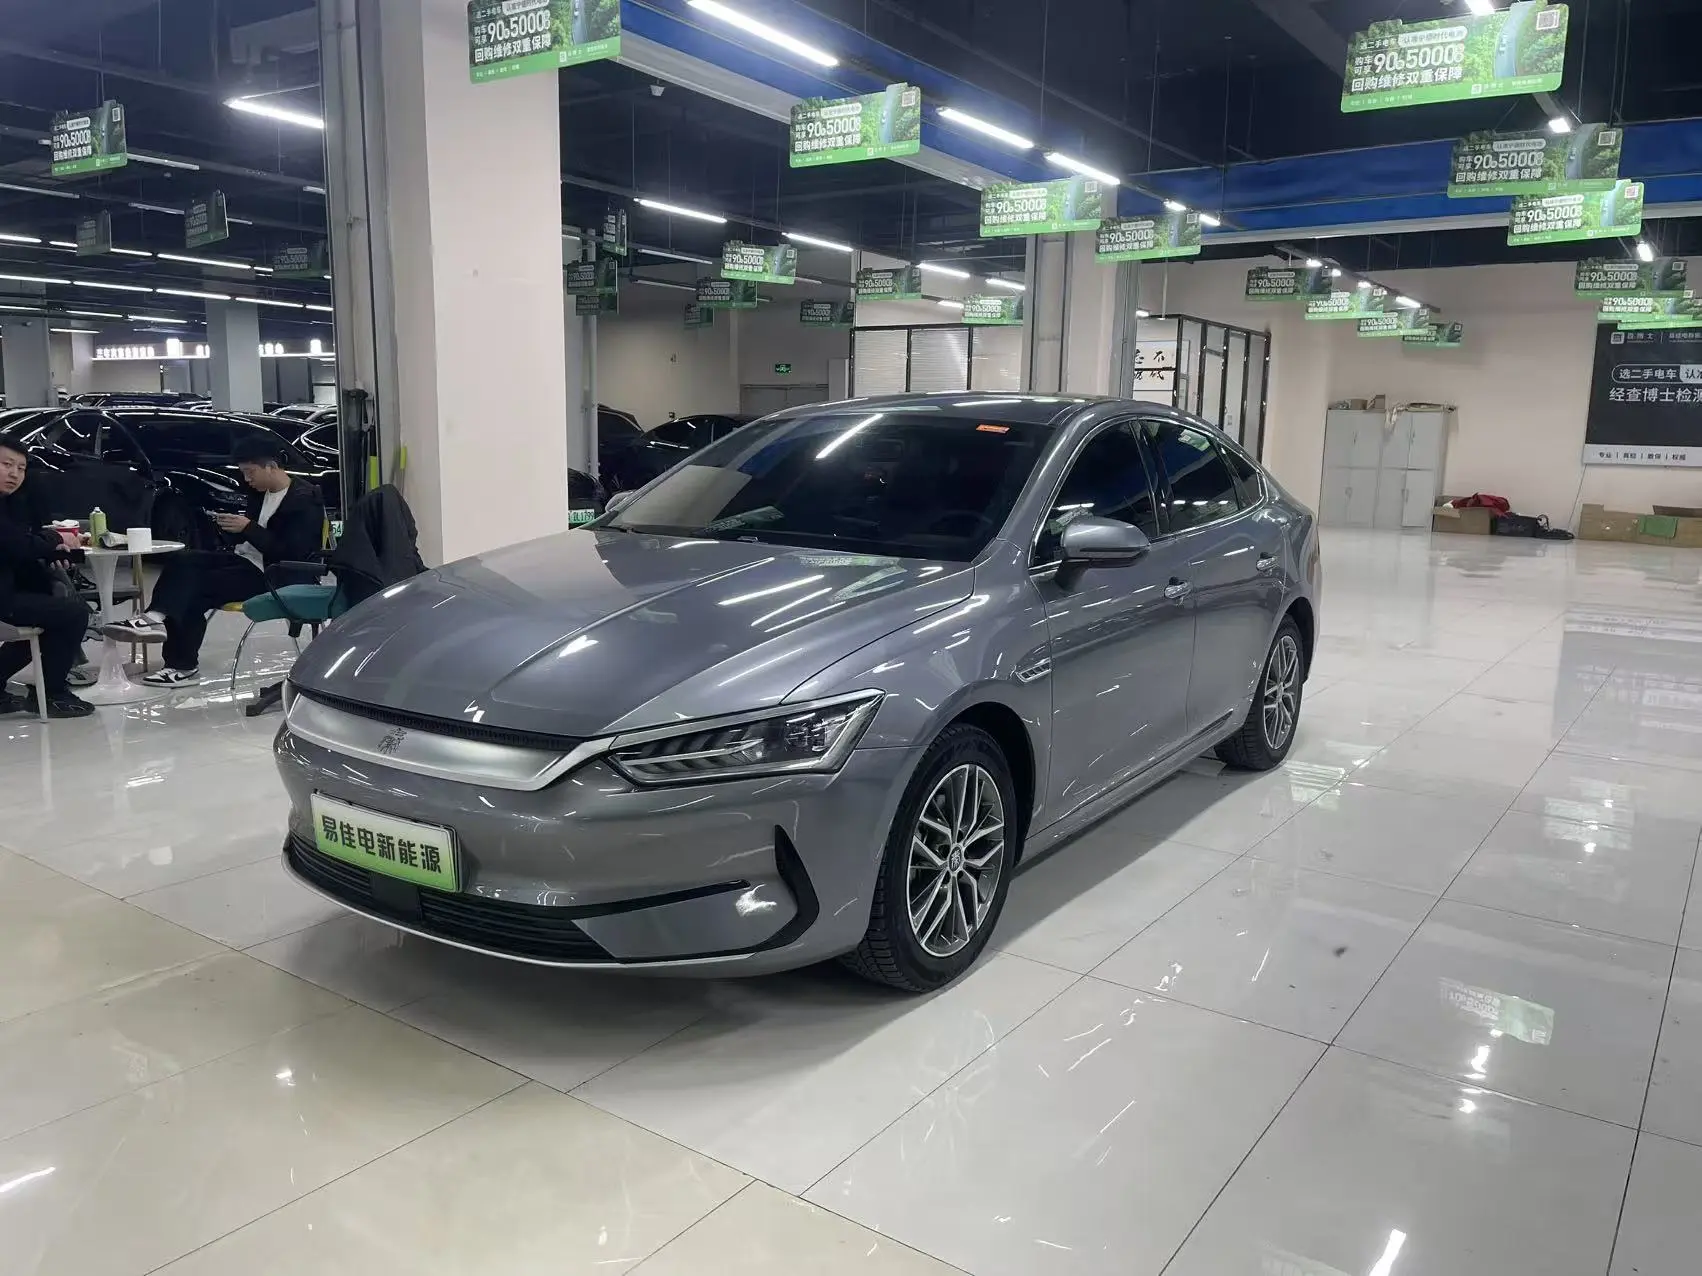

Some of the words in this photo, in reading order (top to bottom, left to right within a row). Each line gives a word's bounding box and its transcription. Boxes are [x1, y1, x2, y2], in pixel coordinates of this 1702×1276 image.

[1352, 66, 1463, 92] 回购维修双重保障
[1456, 168, 1542, 182] 回购维修双重保障
[1514, 218, 1582, 234] 回购维修双重保障
[1620, 369, 1677, 379] 选二手电车
[321, 815, 442, 873] 易佳电新能源
